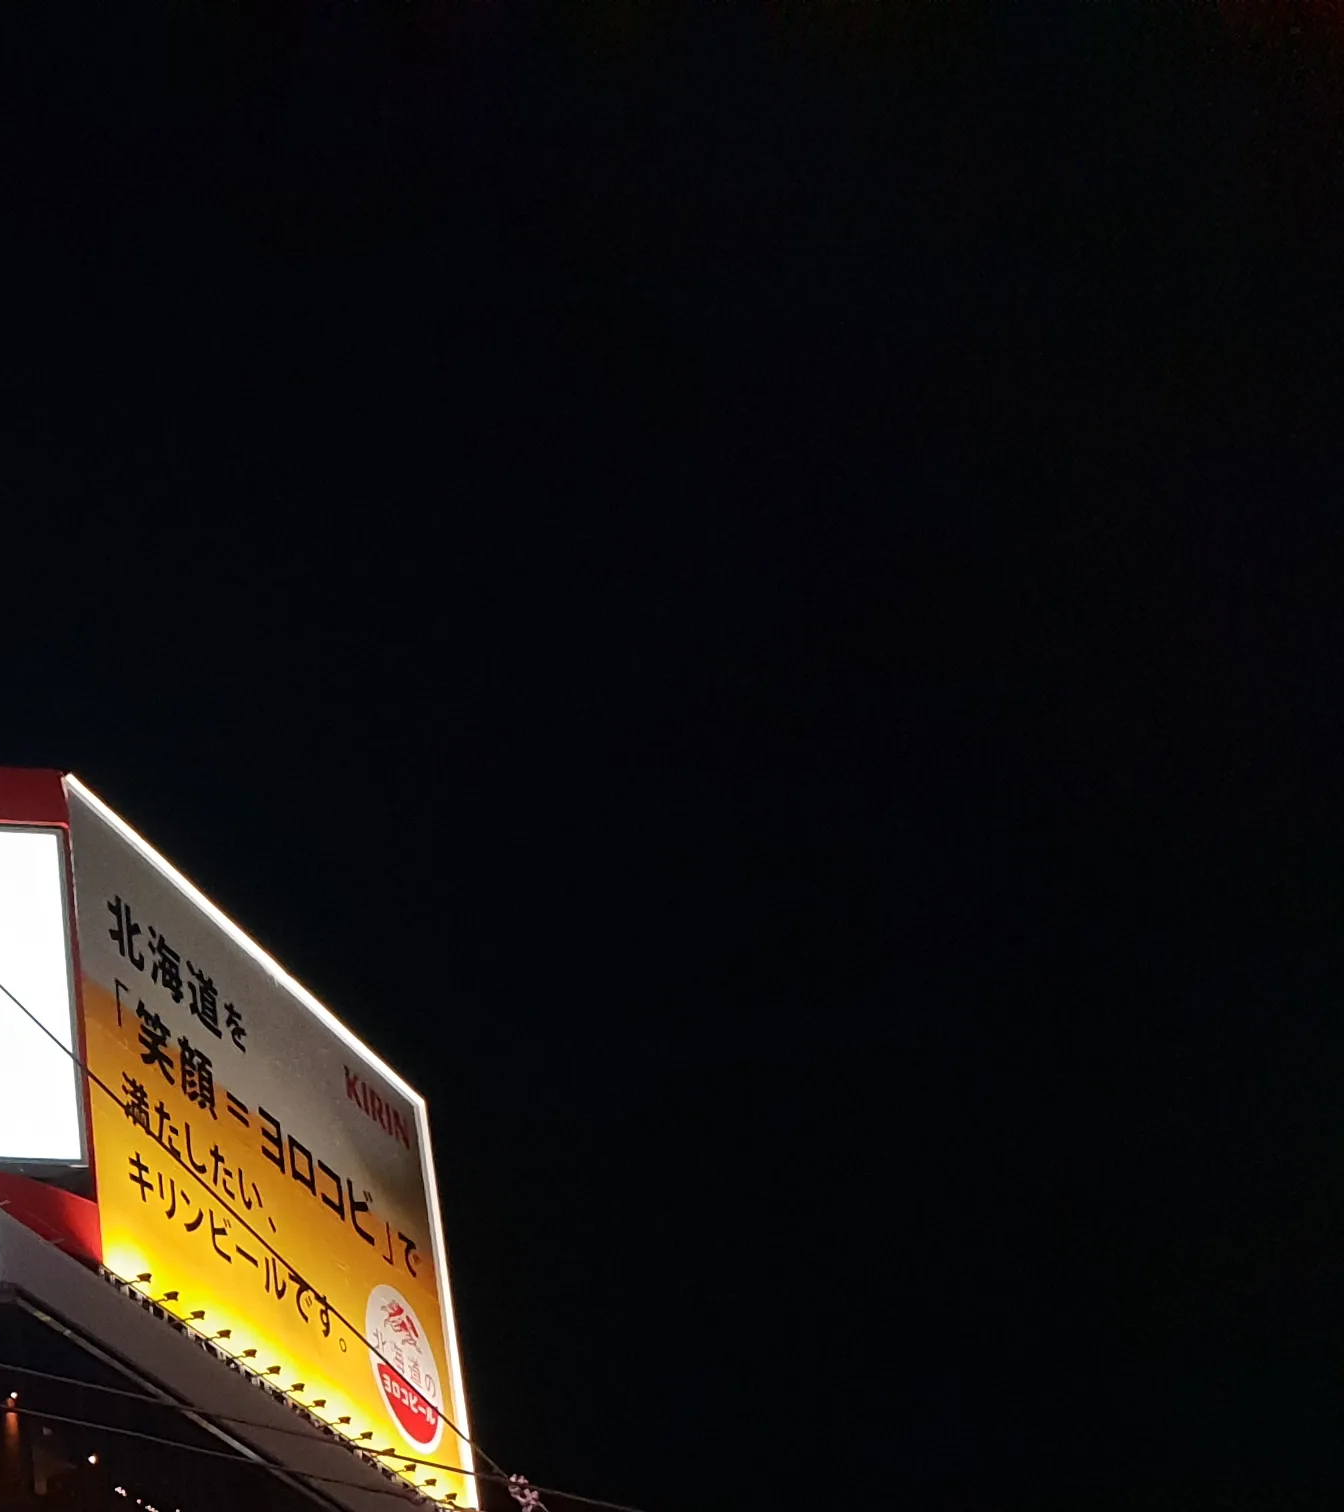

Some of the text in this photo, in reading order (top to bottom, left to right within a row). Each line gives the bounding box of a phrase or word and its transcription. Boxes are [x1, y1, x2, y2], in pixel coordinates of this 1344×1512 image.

[107, 895, 246, 1054] 北海道を
[122, 1072, 278, 1233] 満たしたい、
[344, 1064, 411, 1150] KIRIN
[128, 1152, 348, 1355] キリンビールです。
